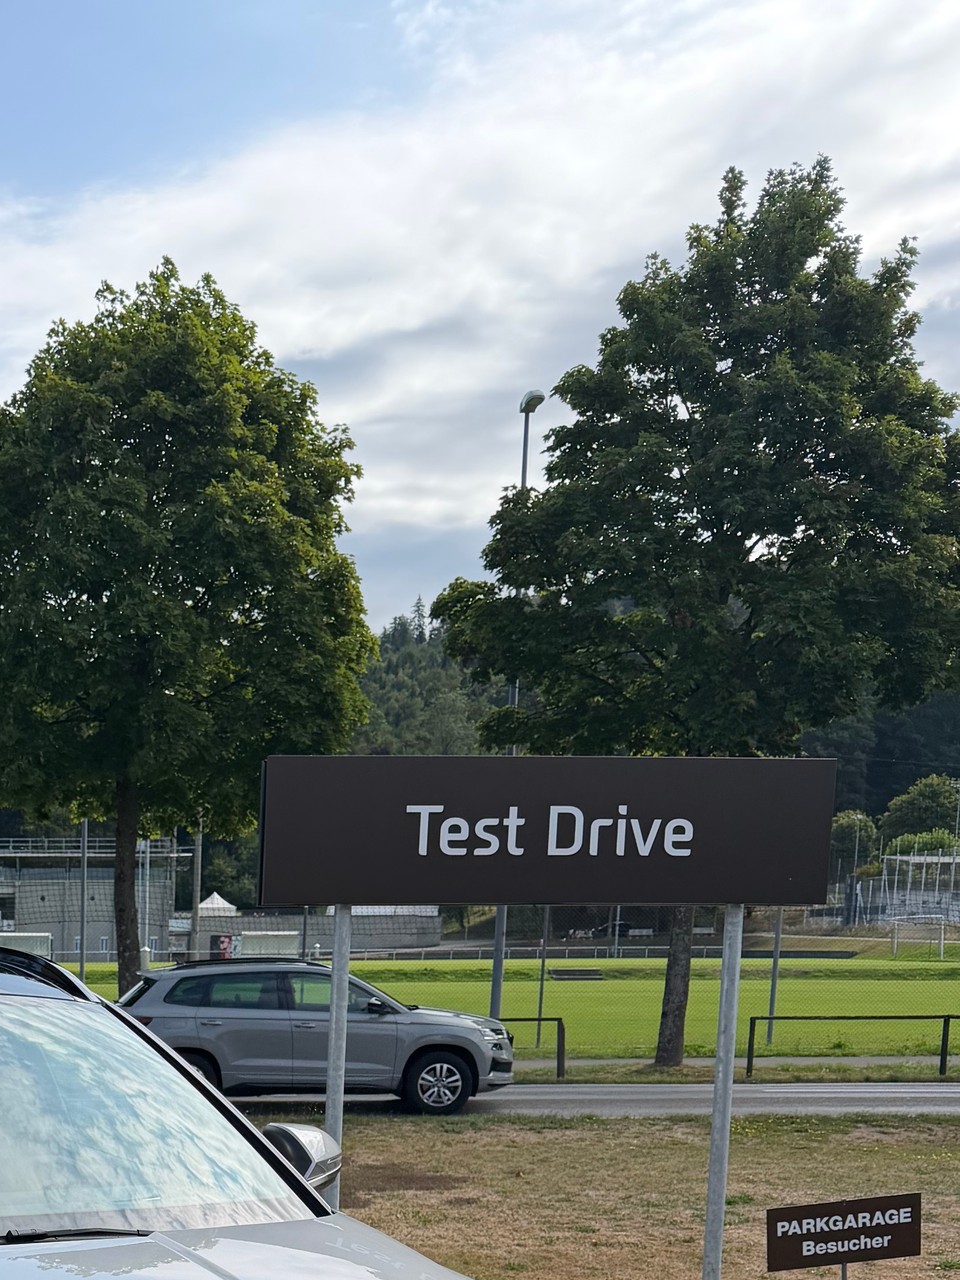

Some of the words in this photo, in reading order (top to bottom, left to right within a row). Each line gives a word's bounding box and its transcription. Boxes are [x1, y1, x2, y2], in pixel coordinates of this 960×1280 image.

[406, 804, 526, 856] Test
[547, 804, 694, 857] Drive
[776, 1207, 912, 1237] PARKGARAGE
[802, 1234, 892, 1256] Besucher
